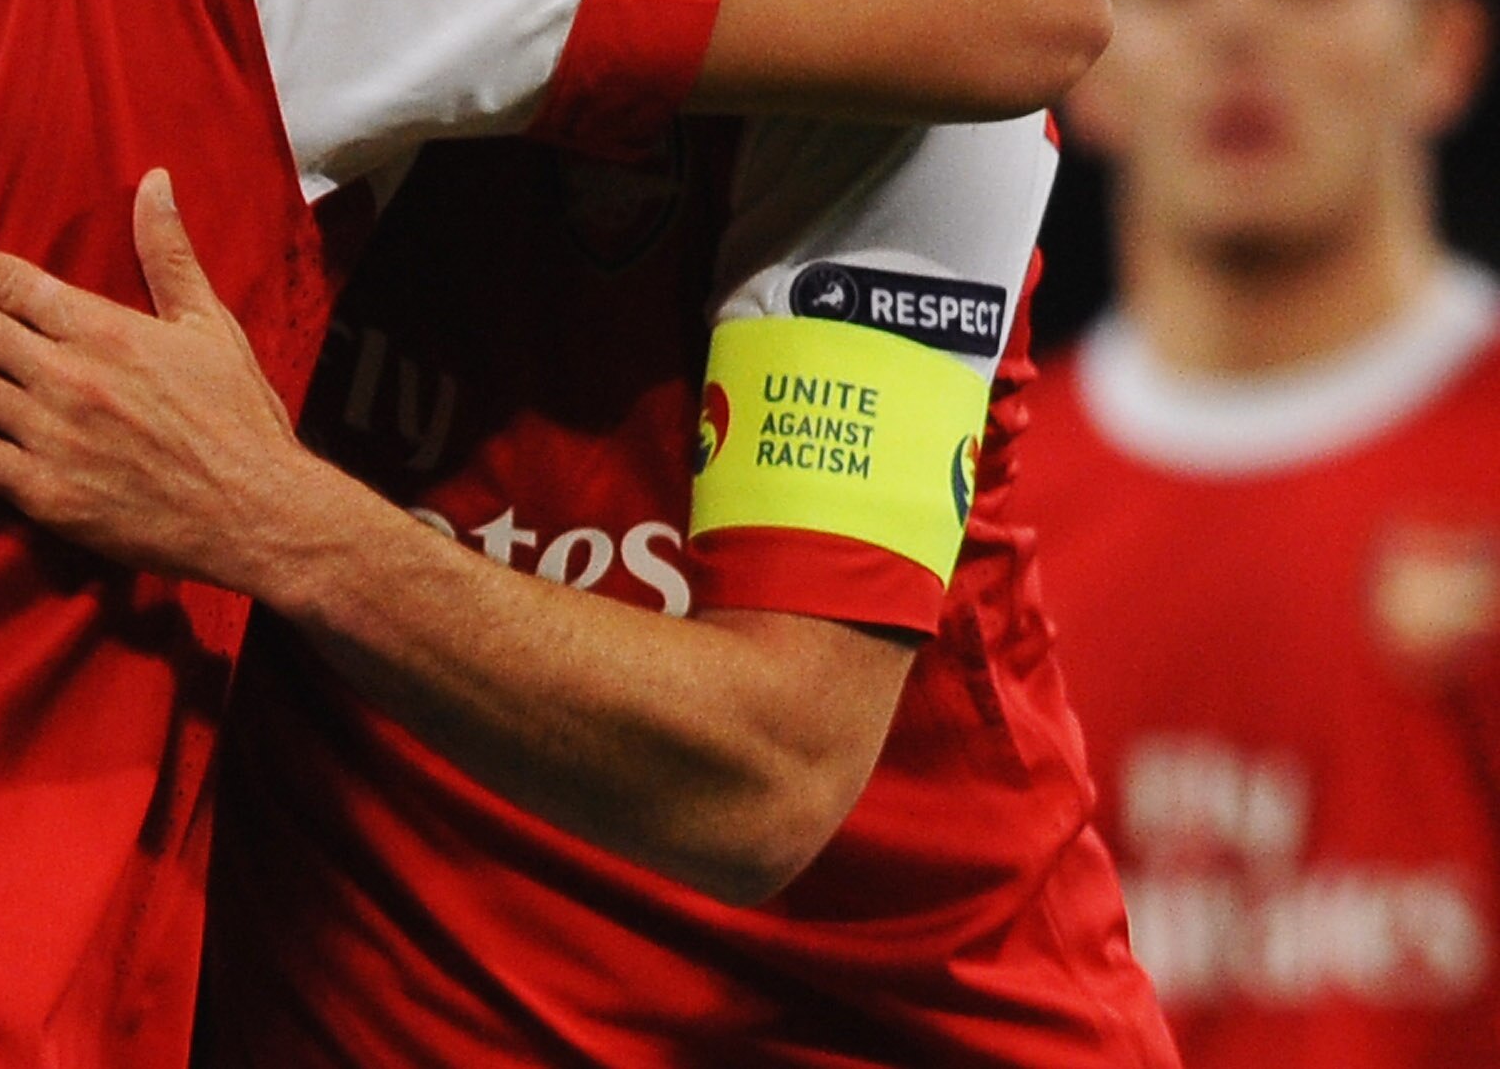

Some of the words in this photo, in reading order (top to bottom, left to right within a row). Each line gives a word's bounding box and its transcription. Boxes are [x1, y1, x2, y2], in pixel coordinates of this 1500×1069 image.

[870, 288, 1001, 337] RESPECT
[329, 319, 457, 471] ly
[764, 374, 878, 417] UNITE
[761, 412, 874, 448] AGAINST
[757, 442, 870, 479] RACISM
